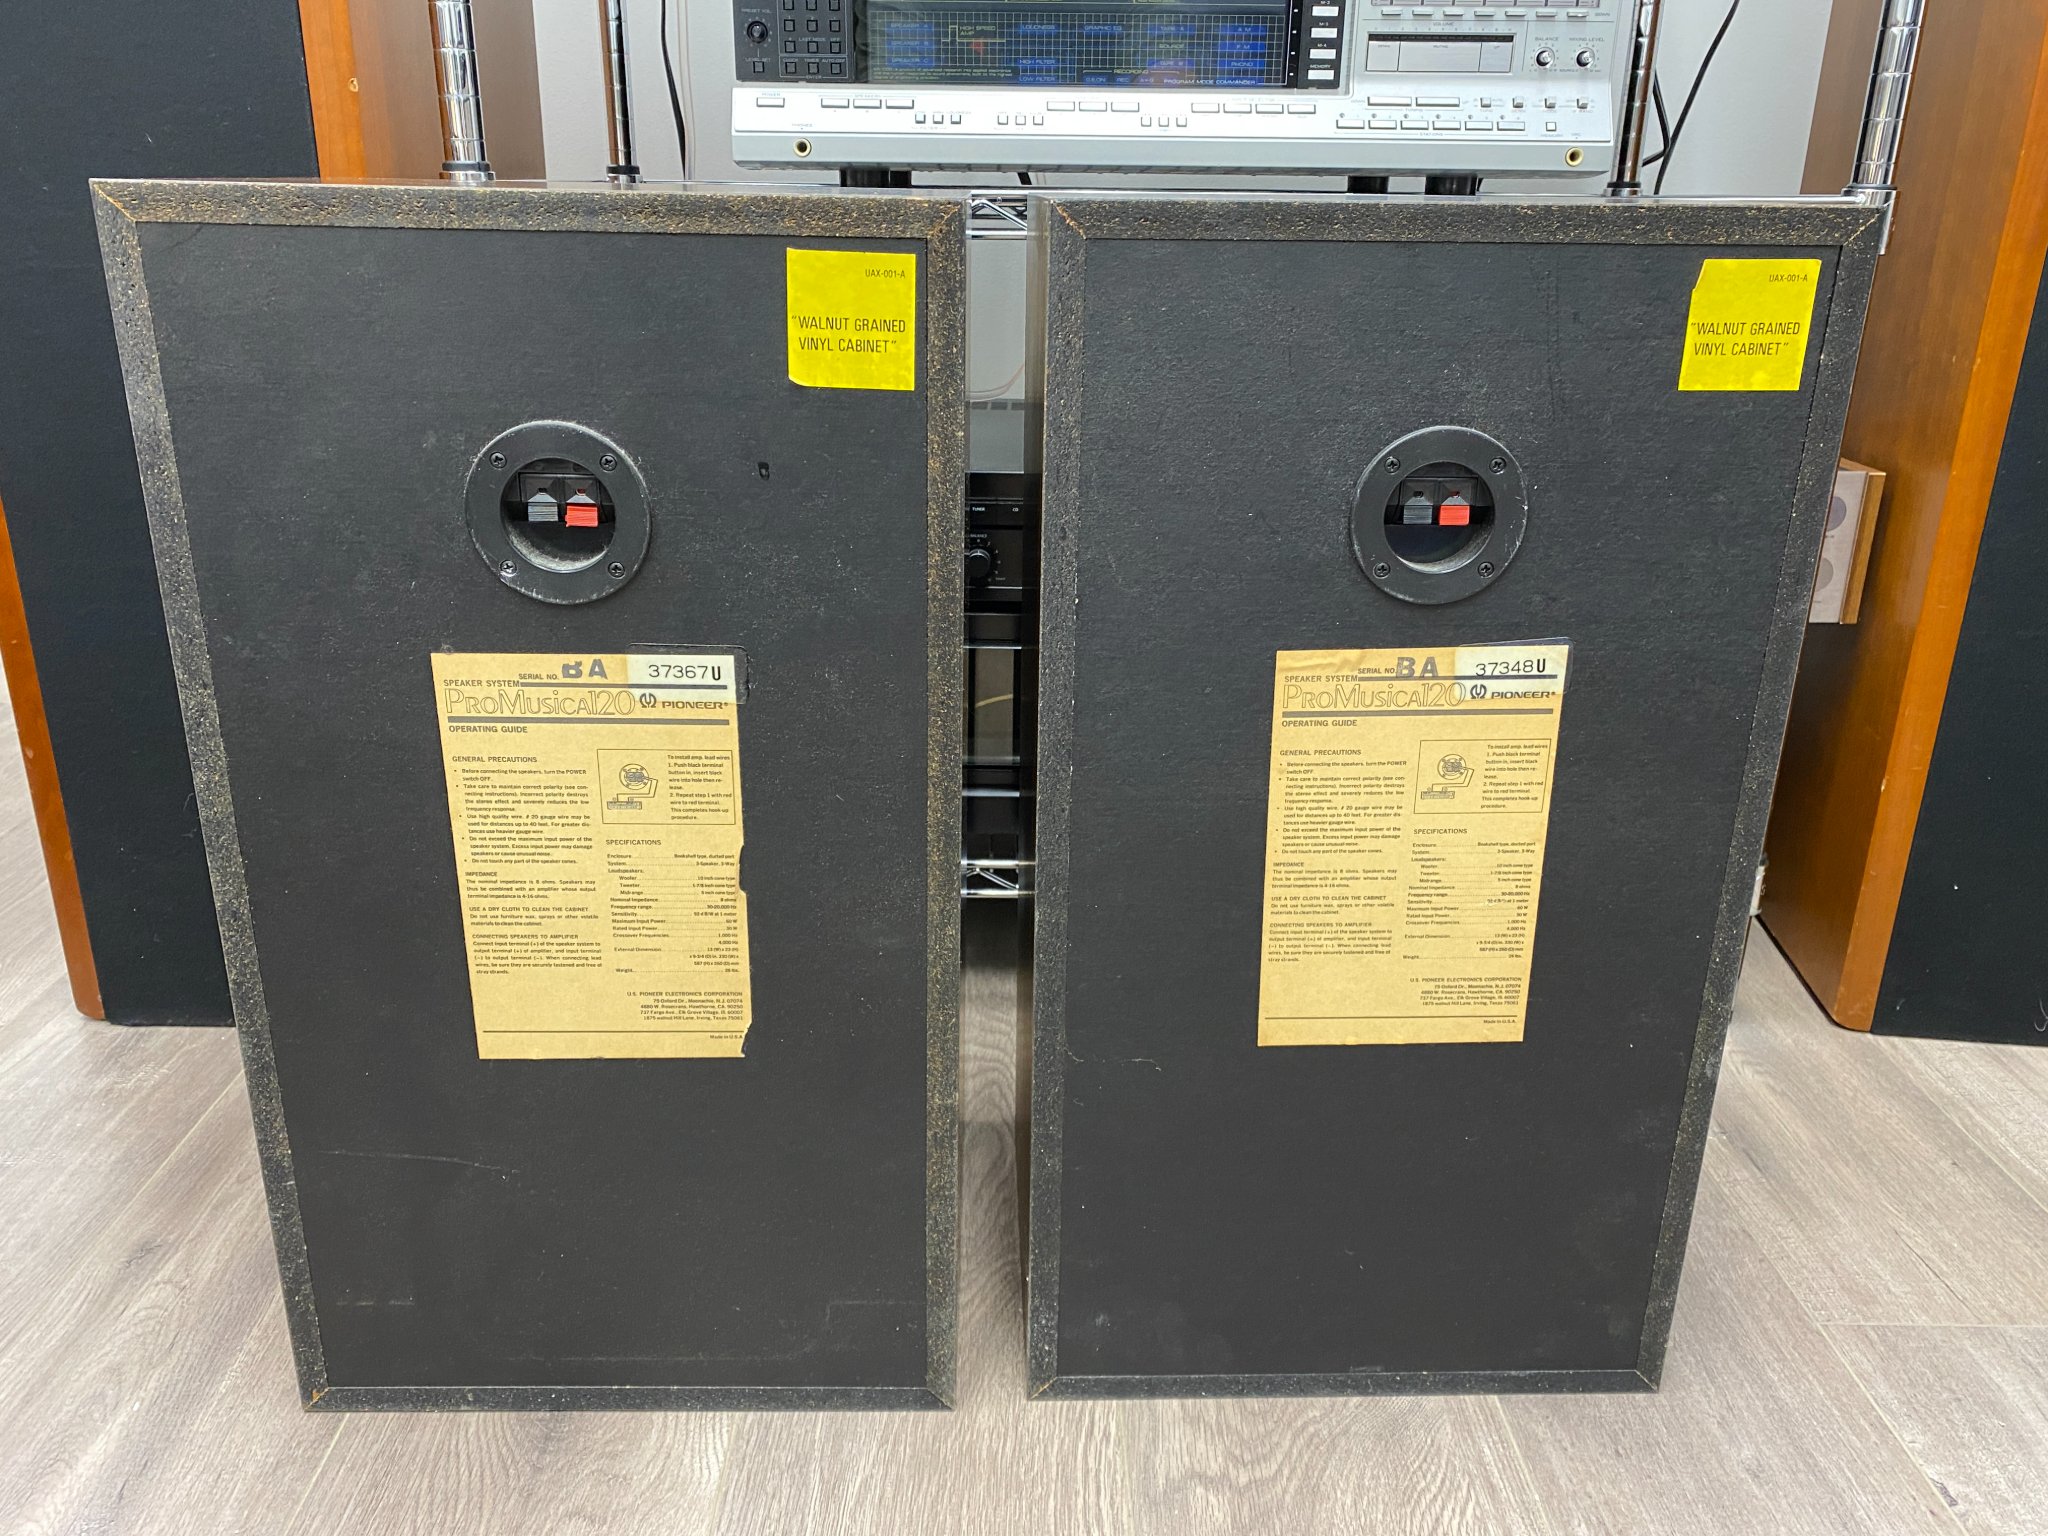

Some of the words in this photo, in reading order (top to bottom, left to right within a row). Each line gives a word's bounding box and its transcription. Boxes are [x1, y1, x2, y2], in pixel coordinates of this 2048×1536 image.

[865, 269, 906, 278] UAX-001-A
[1769, 274, 1808, 282] UAX-001-A
[855, 319, 906, 332] GRAINED
[1750, 322, 1800, 335] GRAINED
[799, 337, 833, 351] VINYL
[1694, 343, 1726, 355] VINYL
[1282, 720, 1329, 728] OPERATING
